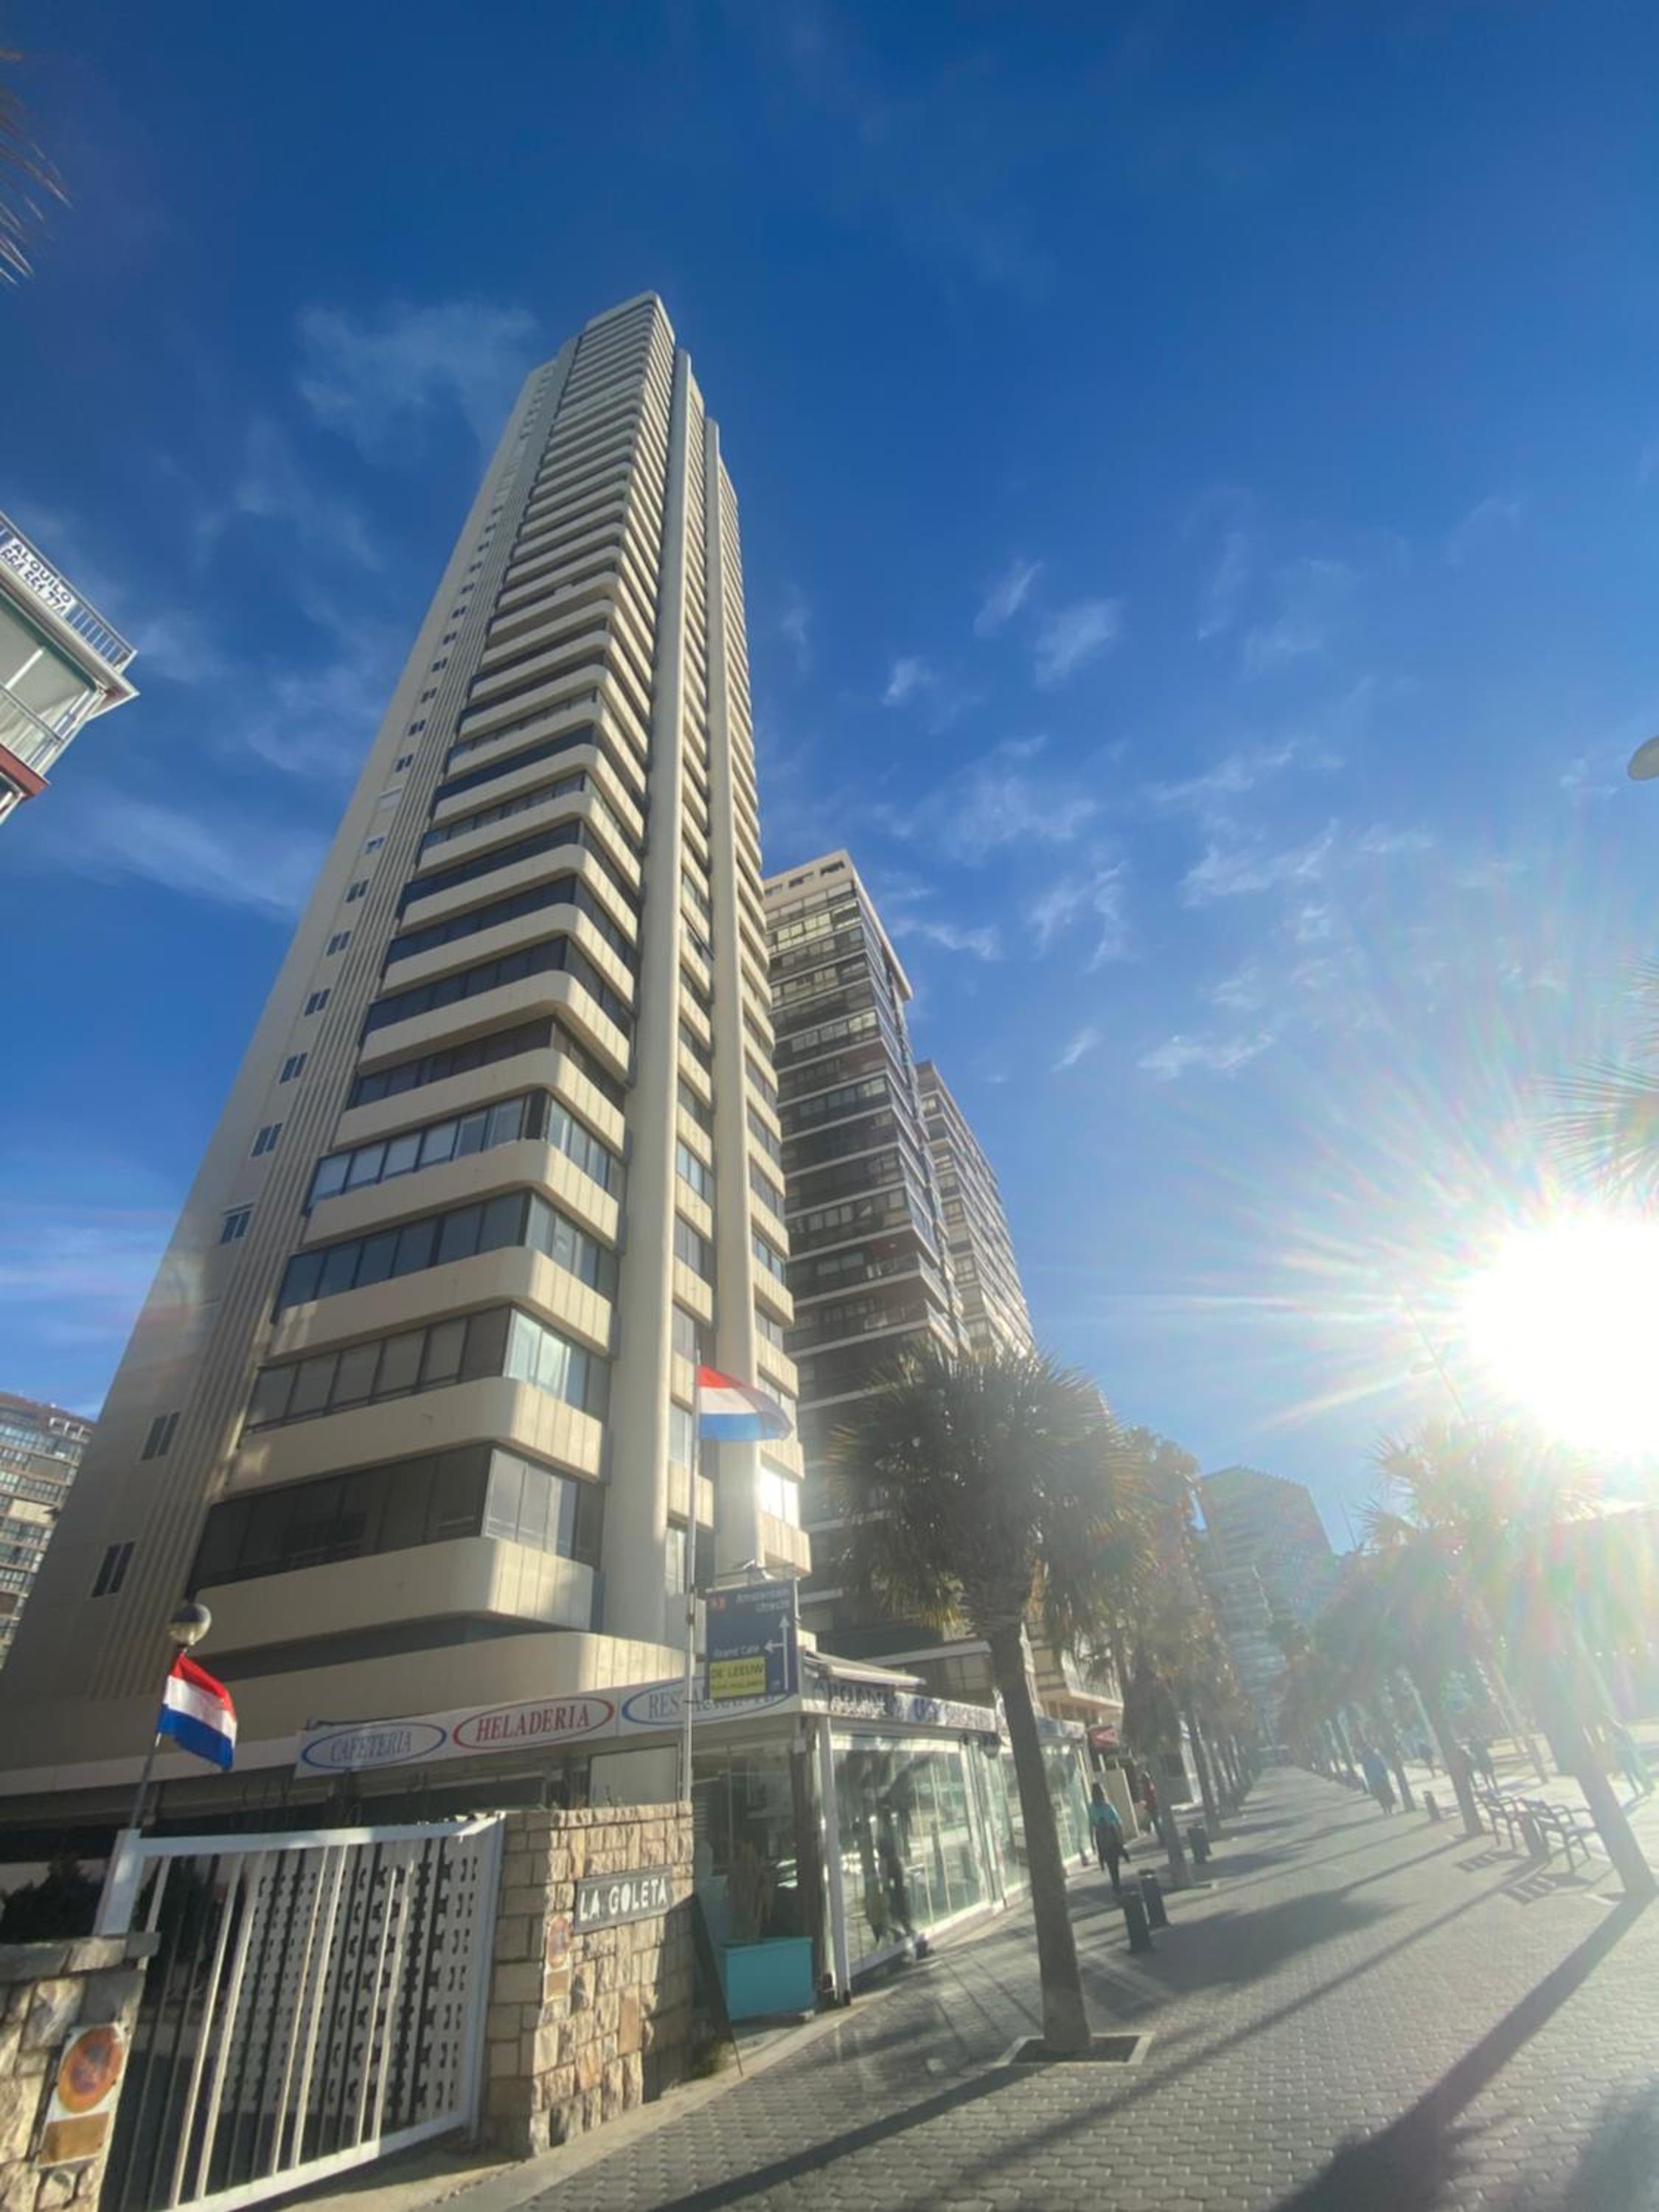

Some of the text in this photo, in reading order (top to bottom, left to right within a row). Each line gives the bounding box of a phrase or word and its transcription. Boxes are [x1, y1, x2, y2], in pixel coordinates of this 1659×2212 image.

[11, 544, 72, 603] ALQUILO
[475, 1705, 590, 1742] HELADERIA
[330, 1731, 412, 1762] CAFETERIA
[580, 1877, 667, 1921] LA GOLETA
